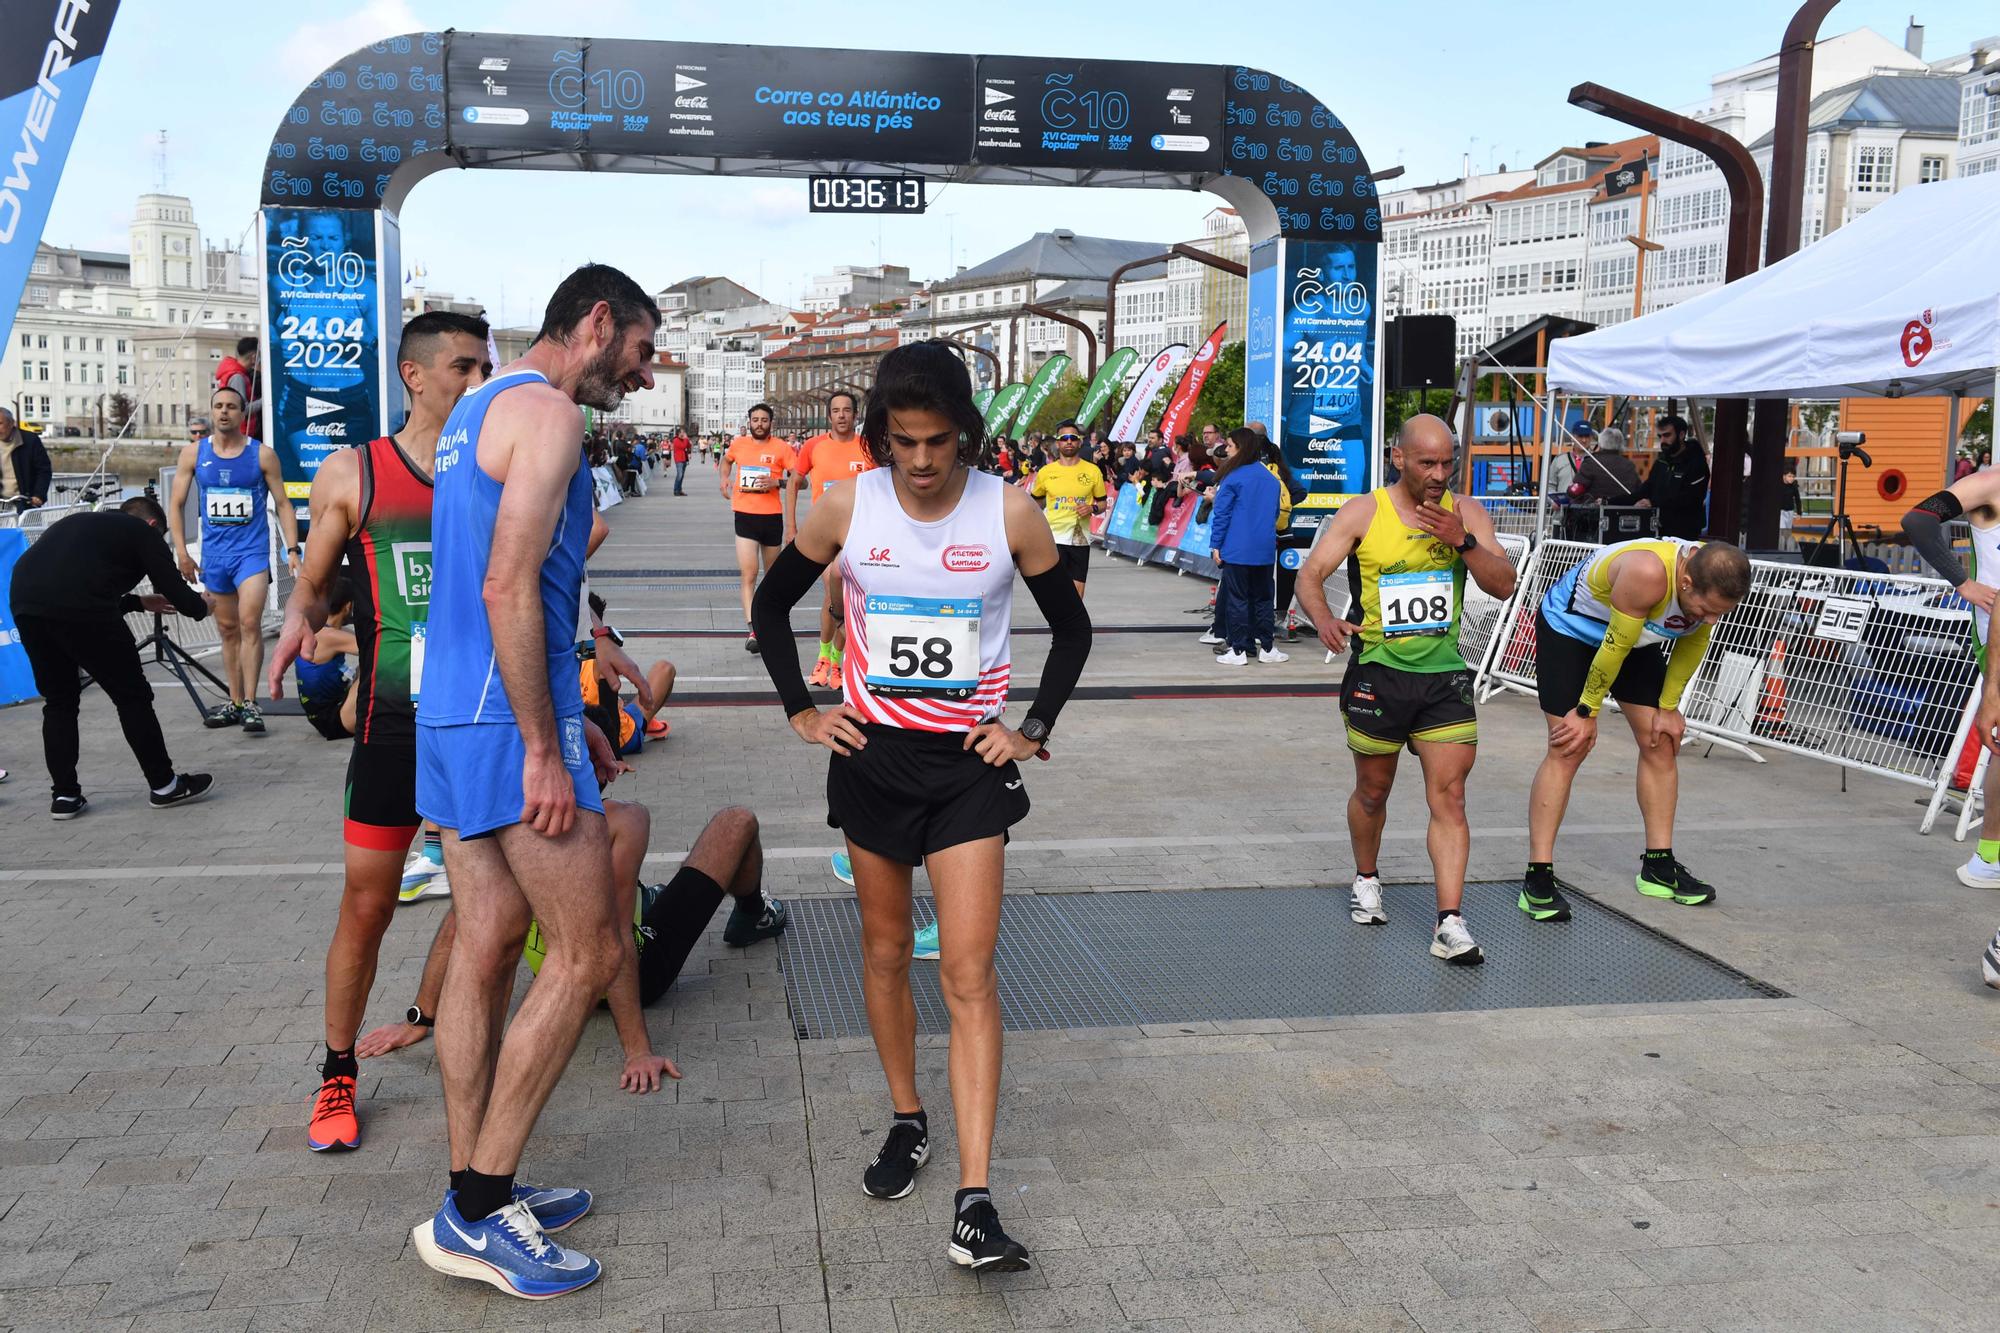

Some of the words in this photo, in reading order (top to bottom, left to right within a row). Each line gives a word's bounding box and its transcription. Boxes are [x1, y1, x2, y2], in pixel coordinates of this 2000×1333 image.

[754, 86, 813, 106] Corre
[818, 91, 844, 107] co
[848, 89, 942, 111] Atlántico
[551, 112, 569, 121] XVI
[570, 112, 614, 122] Carreira
[623, 114, 649, 124] 24.04
[783, 110, 821, 126] aos
[827, 109, 871, 128] teus
[874, 110, 913, 134] pés
[551, 120, 592, 132] Popular
[623, 122, 645, 131] 2022
[1042, 131, 1059, 141] XVI
[1060, 132, 1100, 142] Carreira
[1108, 134, 1133, 143] 24.04
[1042, 140, 1080, 151] Popular
[1108, 142, 1129, 151] 2022
[280, 291, 297, 299] XVI
[296, 291, 332, 300] Carreira
[332, 292, 366, 302] Popular
[280, 316, 364, 341] 24.04
[1293, 318, 1308, 326] XVI
[1308, 318, 1338, 326] Carreira
[1338, 319, 1367, 328] Popular
[284, 341, 363, 369] 2022
[1291, 341, 1363, 363] 24.04
[1293, 364, 1361, 389] 2022
[1302, 457, 1347, 465] POWERADE
[211, 501, 249, 518] 111
[1387, 595, 1448, 626] 108
[889, 636, 953, 679] 58
